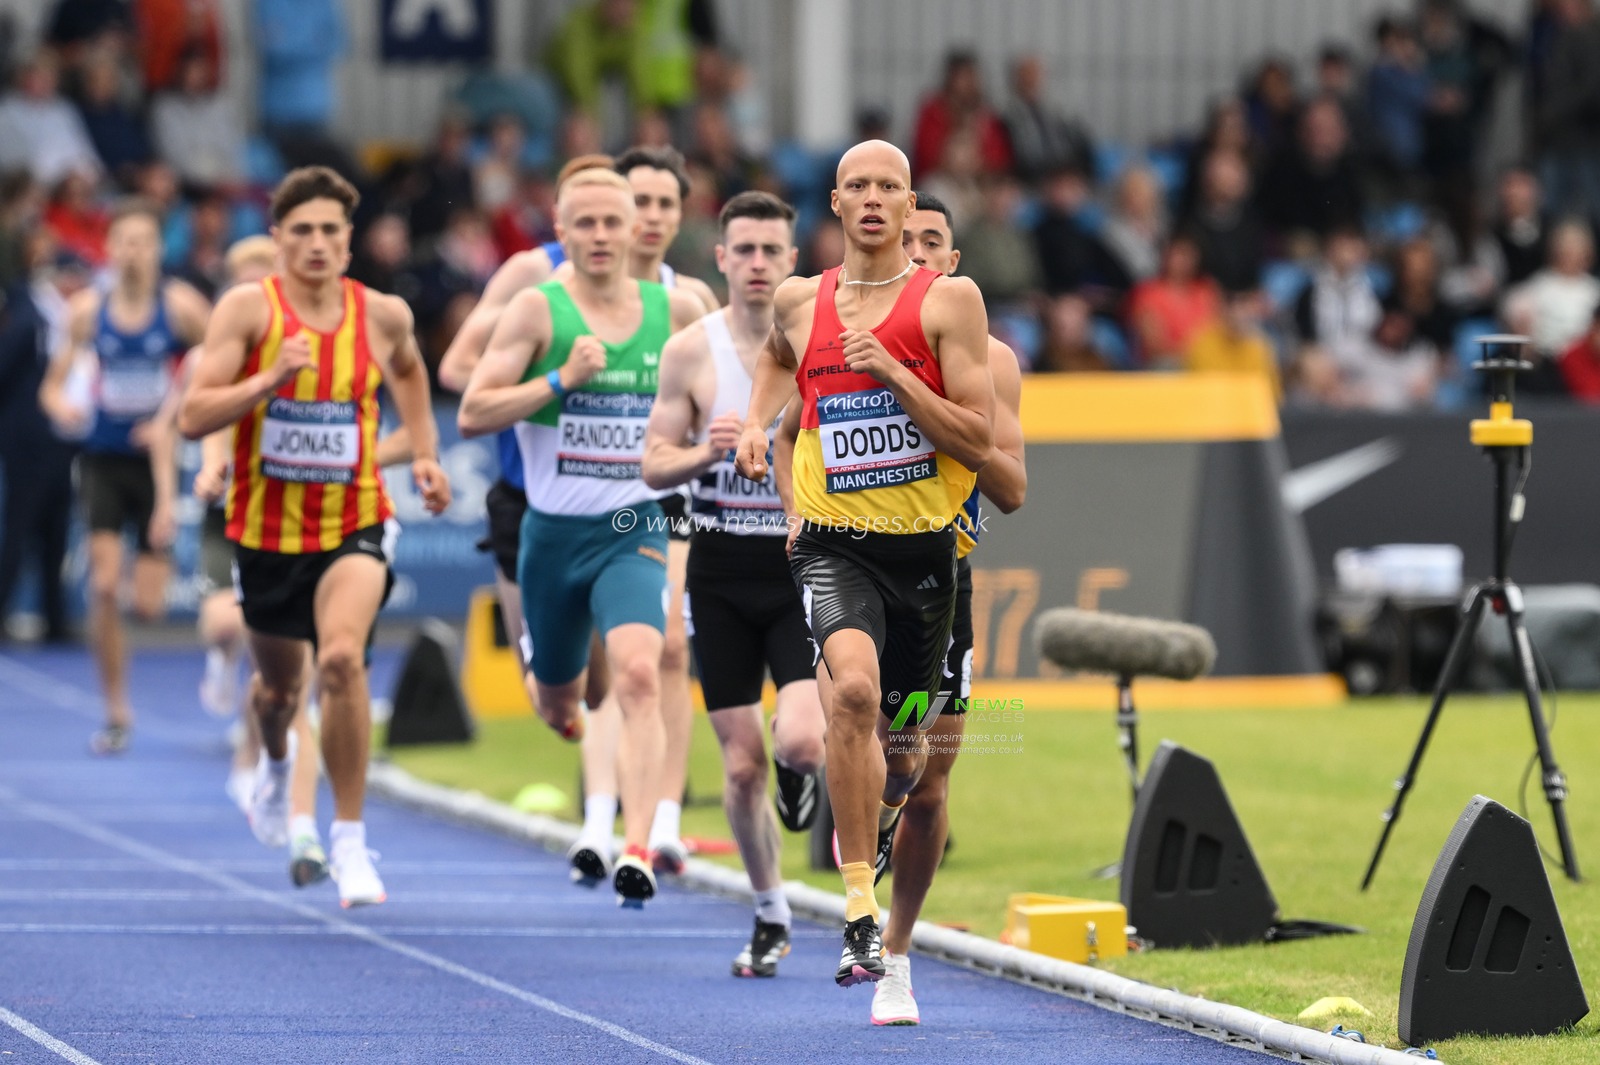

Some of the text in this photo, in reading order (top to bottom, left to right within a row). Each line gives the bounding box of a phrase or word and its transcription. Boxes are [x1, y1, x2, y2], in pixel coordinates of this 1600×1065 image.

[807, 364, 851, 378] ENFIELD
[844, 409, 886, 418] PROCESSING
[272, 429, 346, 458] JONAS
[562, 422, 648, 450] RANDOLP
[833, 420, 921, 460] DODDS
[263, 462, 351, 483] MANCHESTER
[840, 462, 875, 472] ATHLETICS
[876, 453, 930, 468] CHAMPIONSHIPS
[833, 463, 930, 490] MANCHESTER
